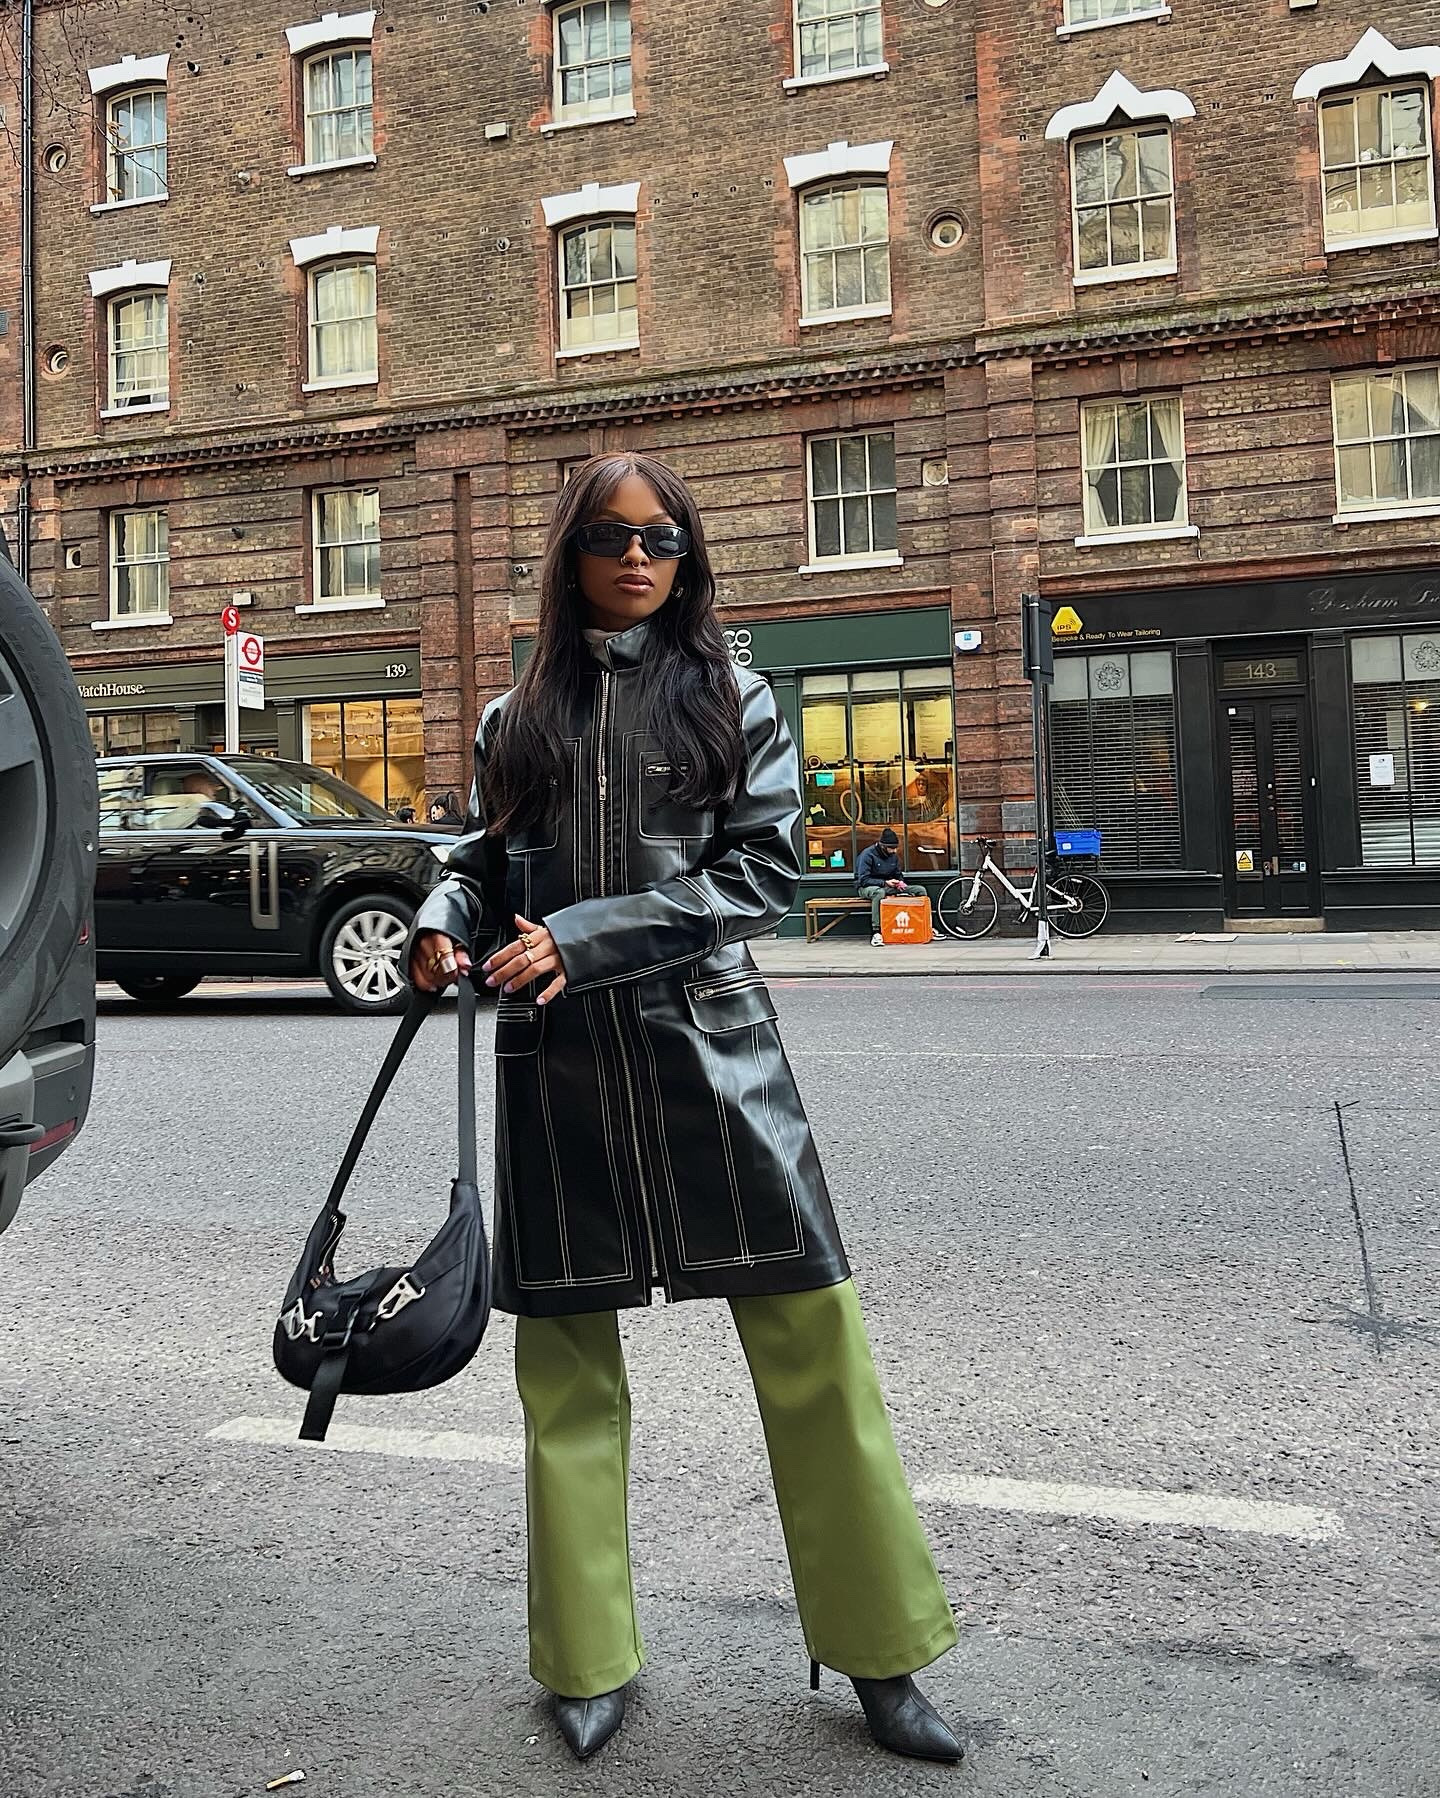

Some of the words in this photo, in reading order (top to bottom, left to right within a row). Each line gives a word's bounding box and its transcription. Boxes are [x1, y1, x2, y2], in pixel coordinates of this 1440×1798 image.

[228, 608, 237, 627] S
[1086, 632, 1106, 641] Ready
[1117, 630, 1134, 638] Wear
[1135, 629, 1161, 637] Tailoring
[385, 663, 407, 678] 139
[1245, 662, 1277, 679] 143
